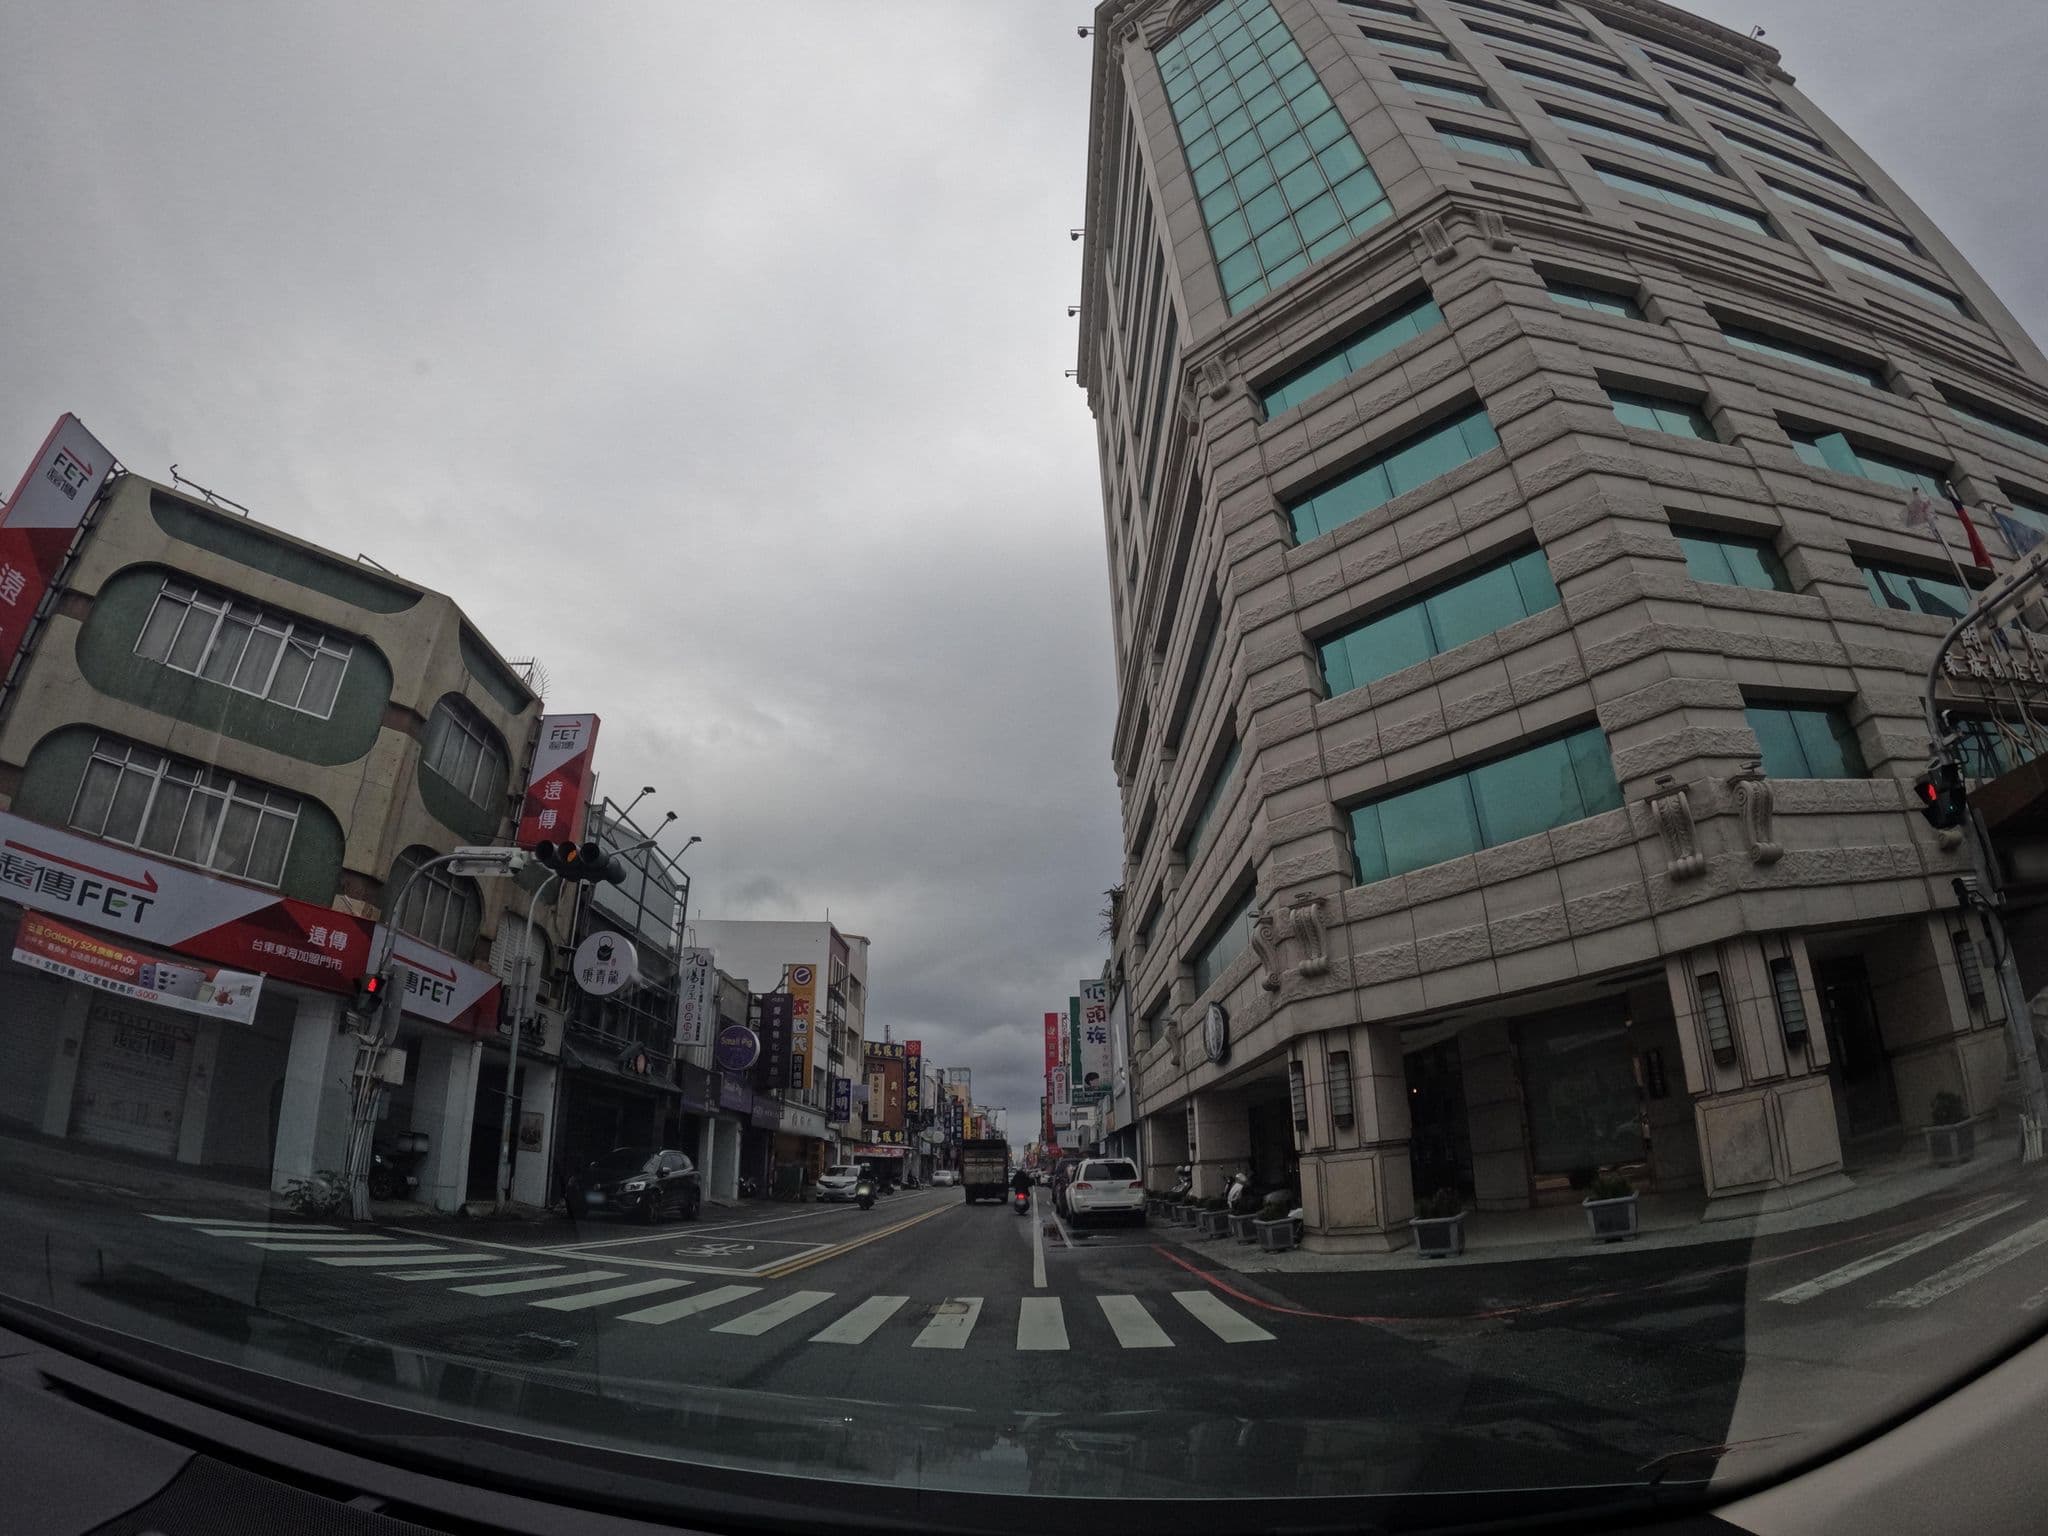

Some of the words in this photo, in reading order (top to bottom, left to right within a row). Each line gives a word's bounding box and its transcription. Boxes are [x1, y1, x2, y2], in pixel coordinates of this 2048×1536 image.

[53, 451, 91, 488] FET
[551, 729, 580, 741] FET
[537, 781, 563, 830] 遠傳
[77, 879, 154, 923] FET
[307, 924, 348, 951] 遠傳
[252, 939, 343, 971] 台東東海加盟門市
[419, 977, 455, 1006] FET
[583, 969, 619, 985] 康青龍
